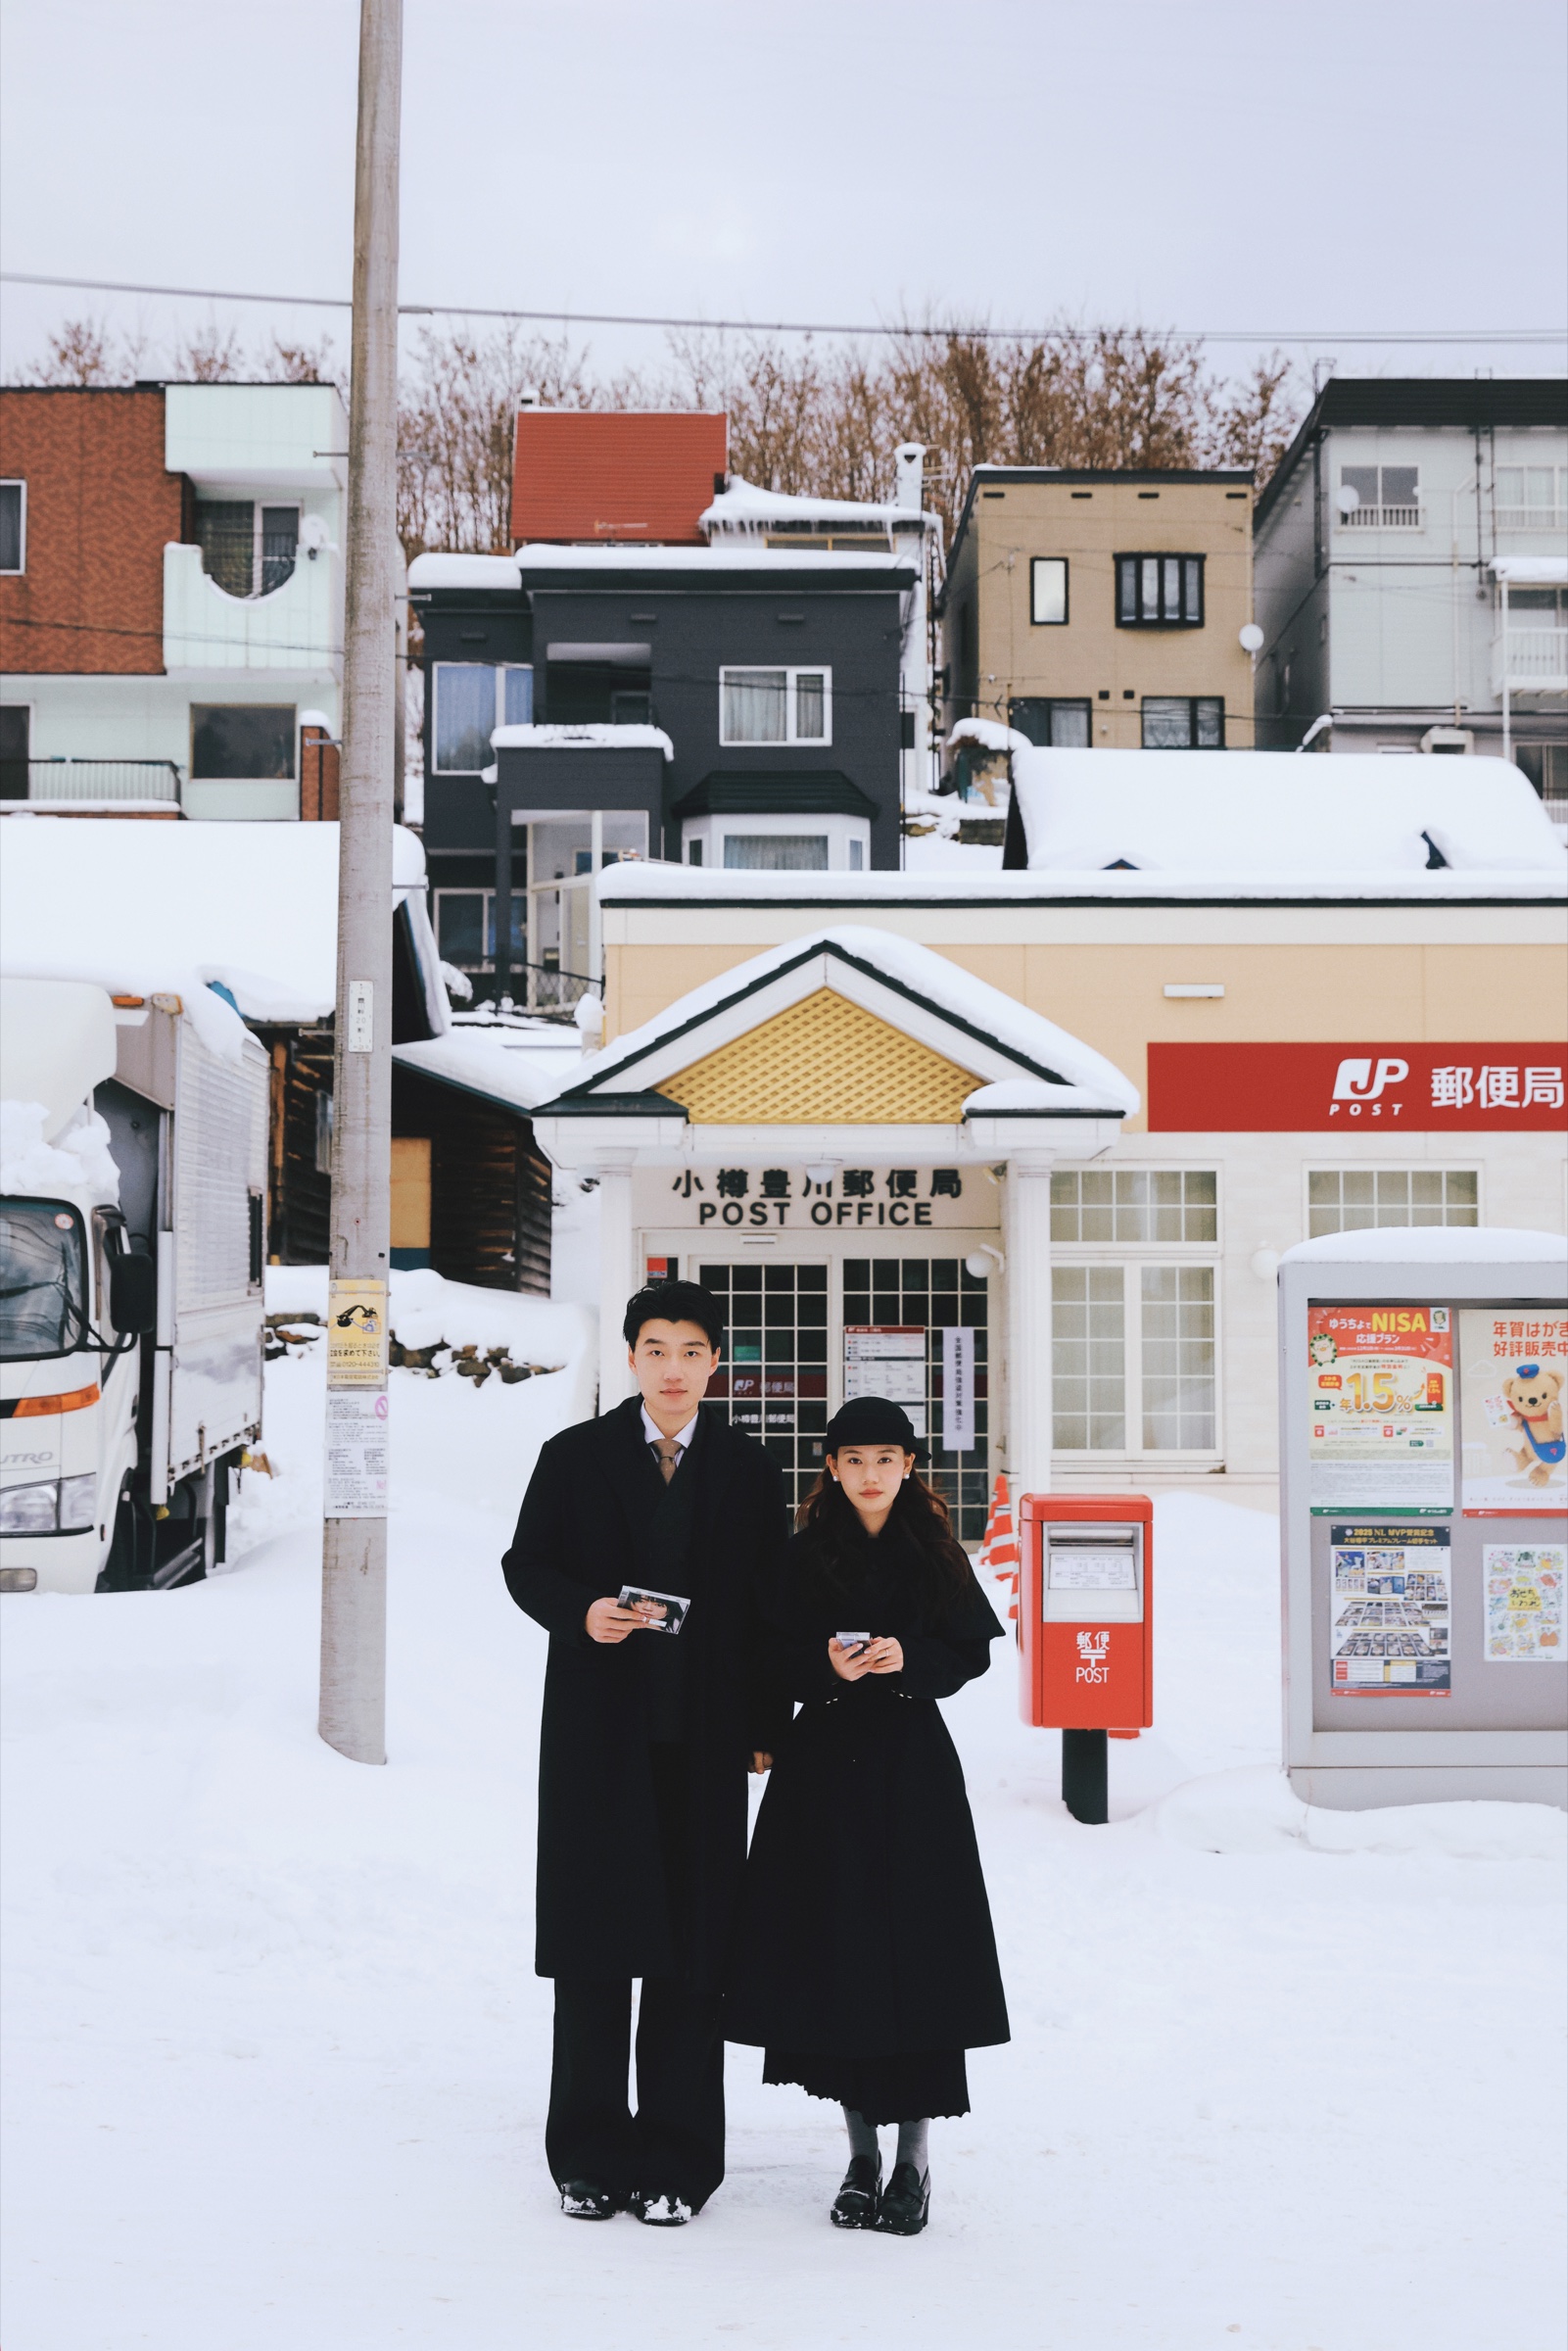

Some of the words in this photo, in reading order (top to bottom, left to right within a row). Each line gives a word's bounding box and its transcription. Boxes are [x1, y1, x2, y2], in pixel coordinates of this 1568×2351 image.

[1332, 1058, 1409, 1100] JP
[1431, 1066, 1565, 1109] 郵便局
[1329, 1103, 1403, 1117] POST
[672, 1169, 962, 1198] 小樽豊川郵便局
[699, 1202, 790, 1225] POST
[810, 1202, 932, 1225] OFFICE
[1355, 1333, 1400, 1344] 応援プラン
[1075, 1630, 1111, 1650] 郵便
[1075, 1666, 1111, 1684] POST
